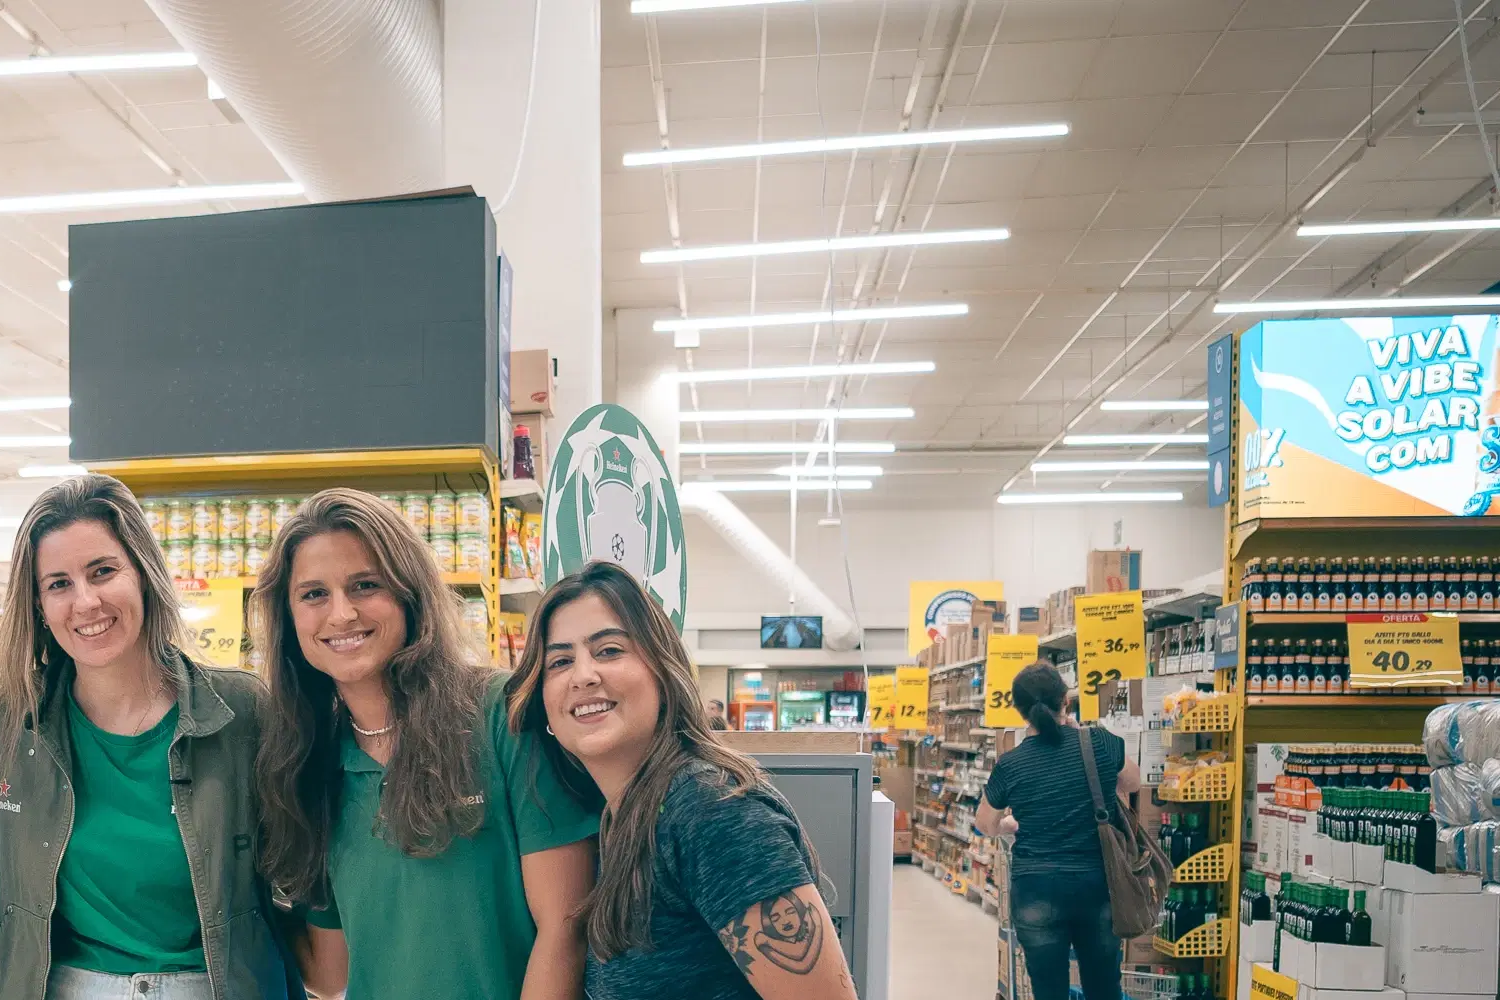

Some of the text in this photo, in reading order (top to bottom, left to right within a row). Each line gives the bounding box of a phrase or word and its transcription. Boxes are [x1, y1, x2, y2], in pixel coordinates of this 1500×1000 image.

[1366, 325, 1470, 369] VIVA
[1345, 361, 1482, 405] A VIBE
[1335, 397, 1480, 442] SOLAR
[1365, 434, 1453, 473] COM
[1382, 614, 1421, 623] OFERTA
[1372, 650, 1433, 672] 40,29
